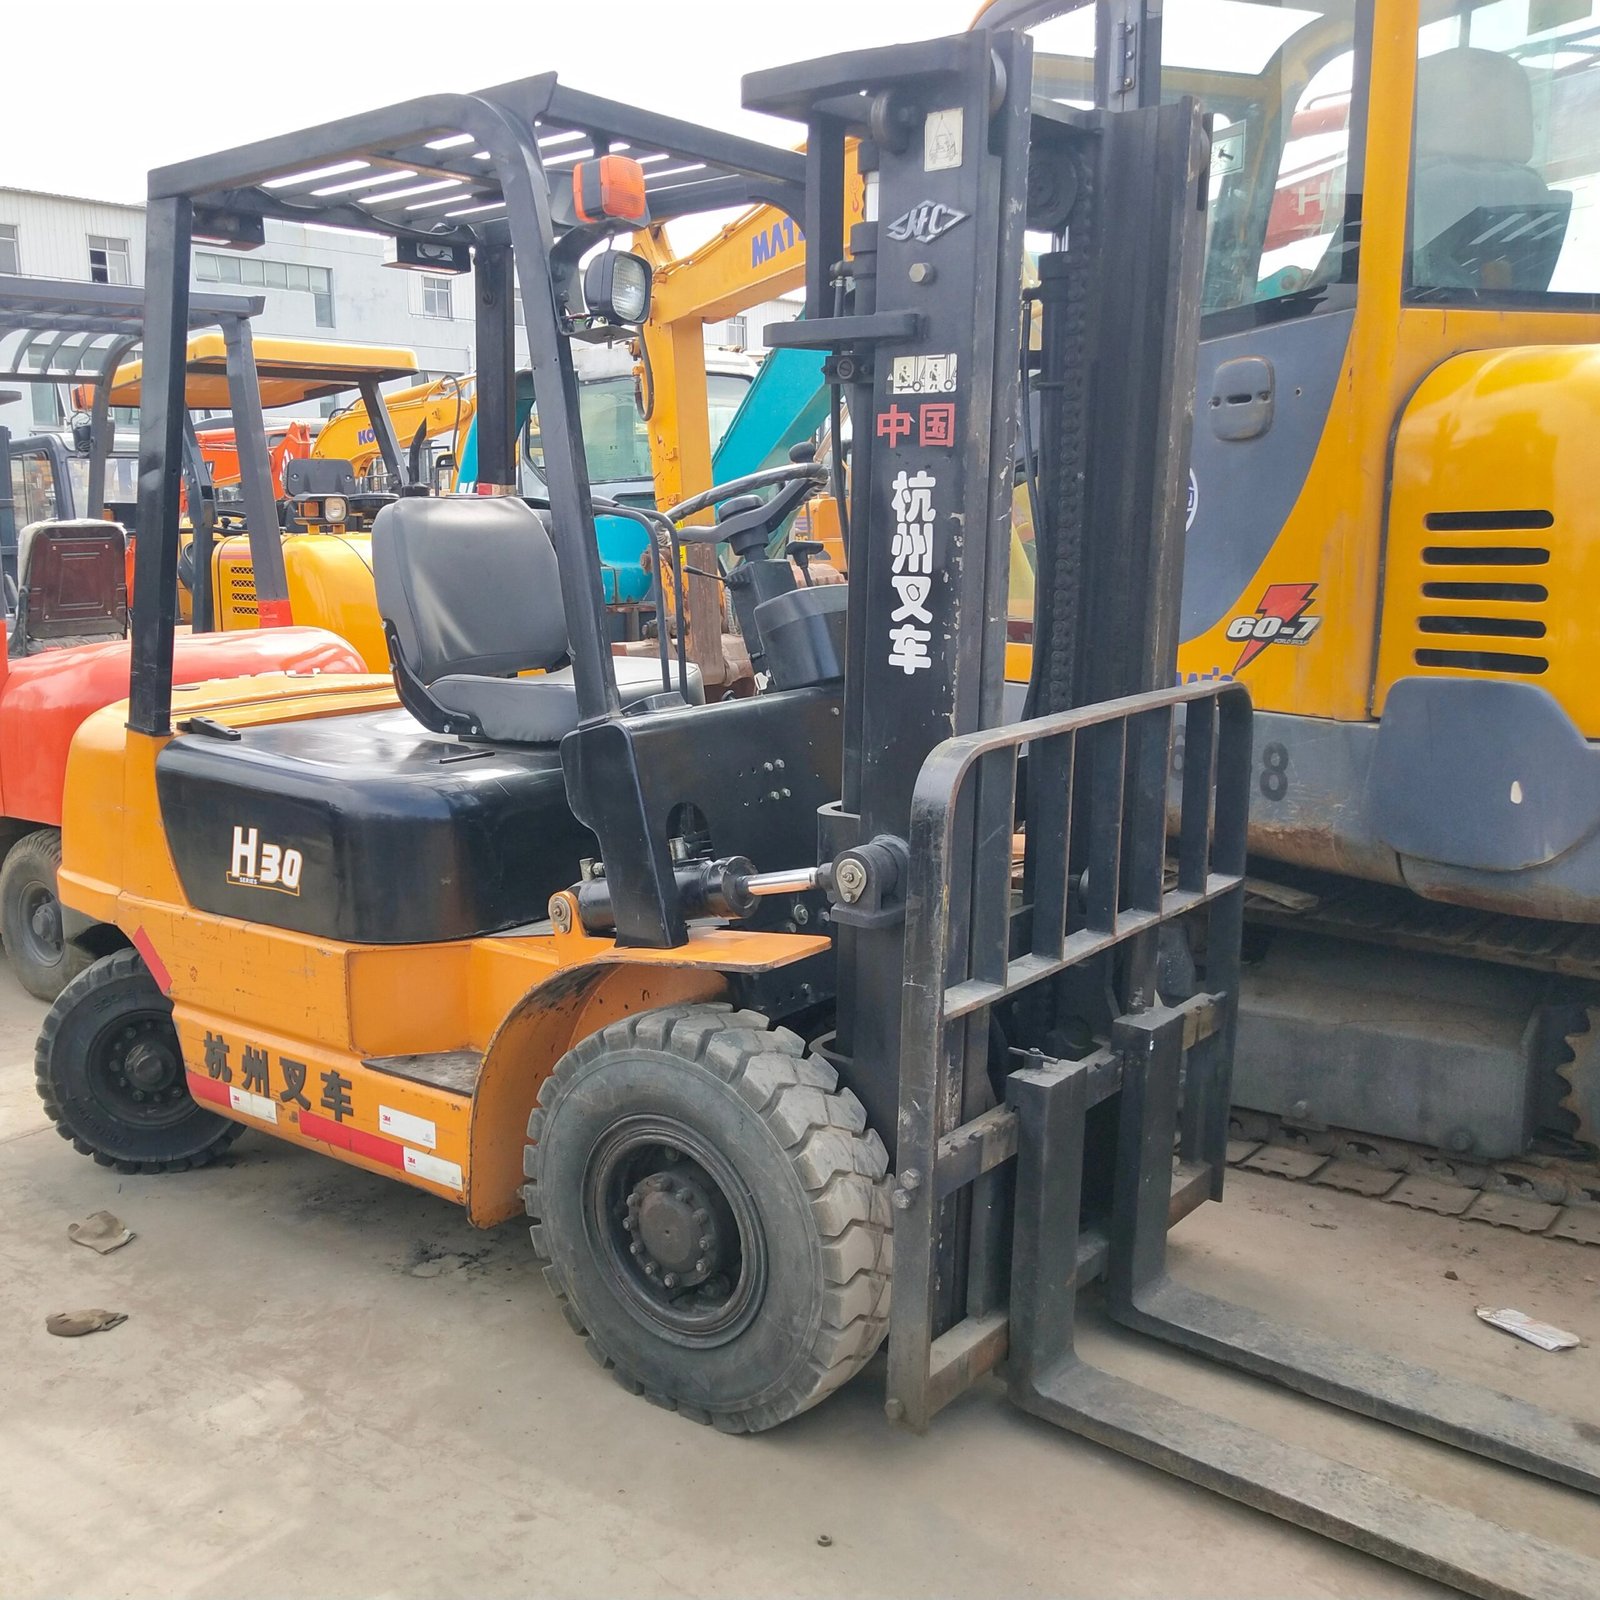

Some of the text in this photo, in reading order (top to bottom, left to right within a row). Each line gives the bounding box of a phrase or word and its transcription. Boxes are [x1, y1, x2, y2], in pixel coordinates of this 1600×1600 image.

[877, 402, 956, 449] 中国
[888, 470, 937, 676] 杭州叉车
[1226, 616, 1321, 641] 60-7
[231, 826, 303, 889] H30
[204, 1030, 354, 1123] 杭州叉车
